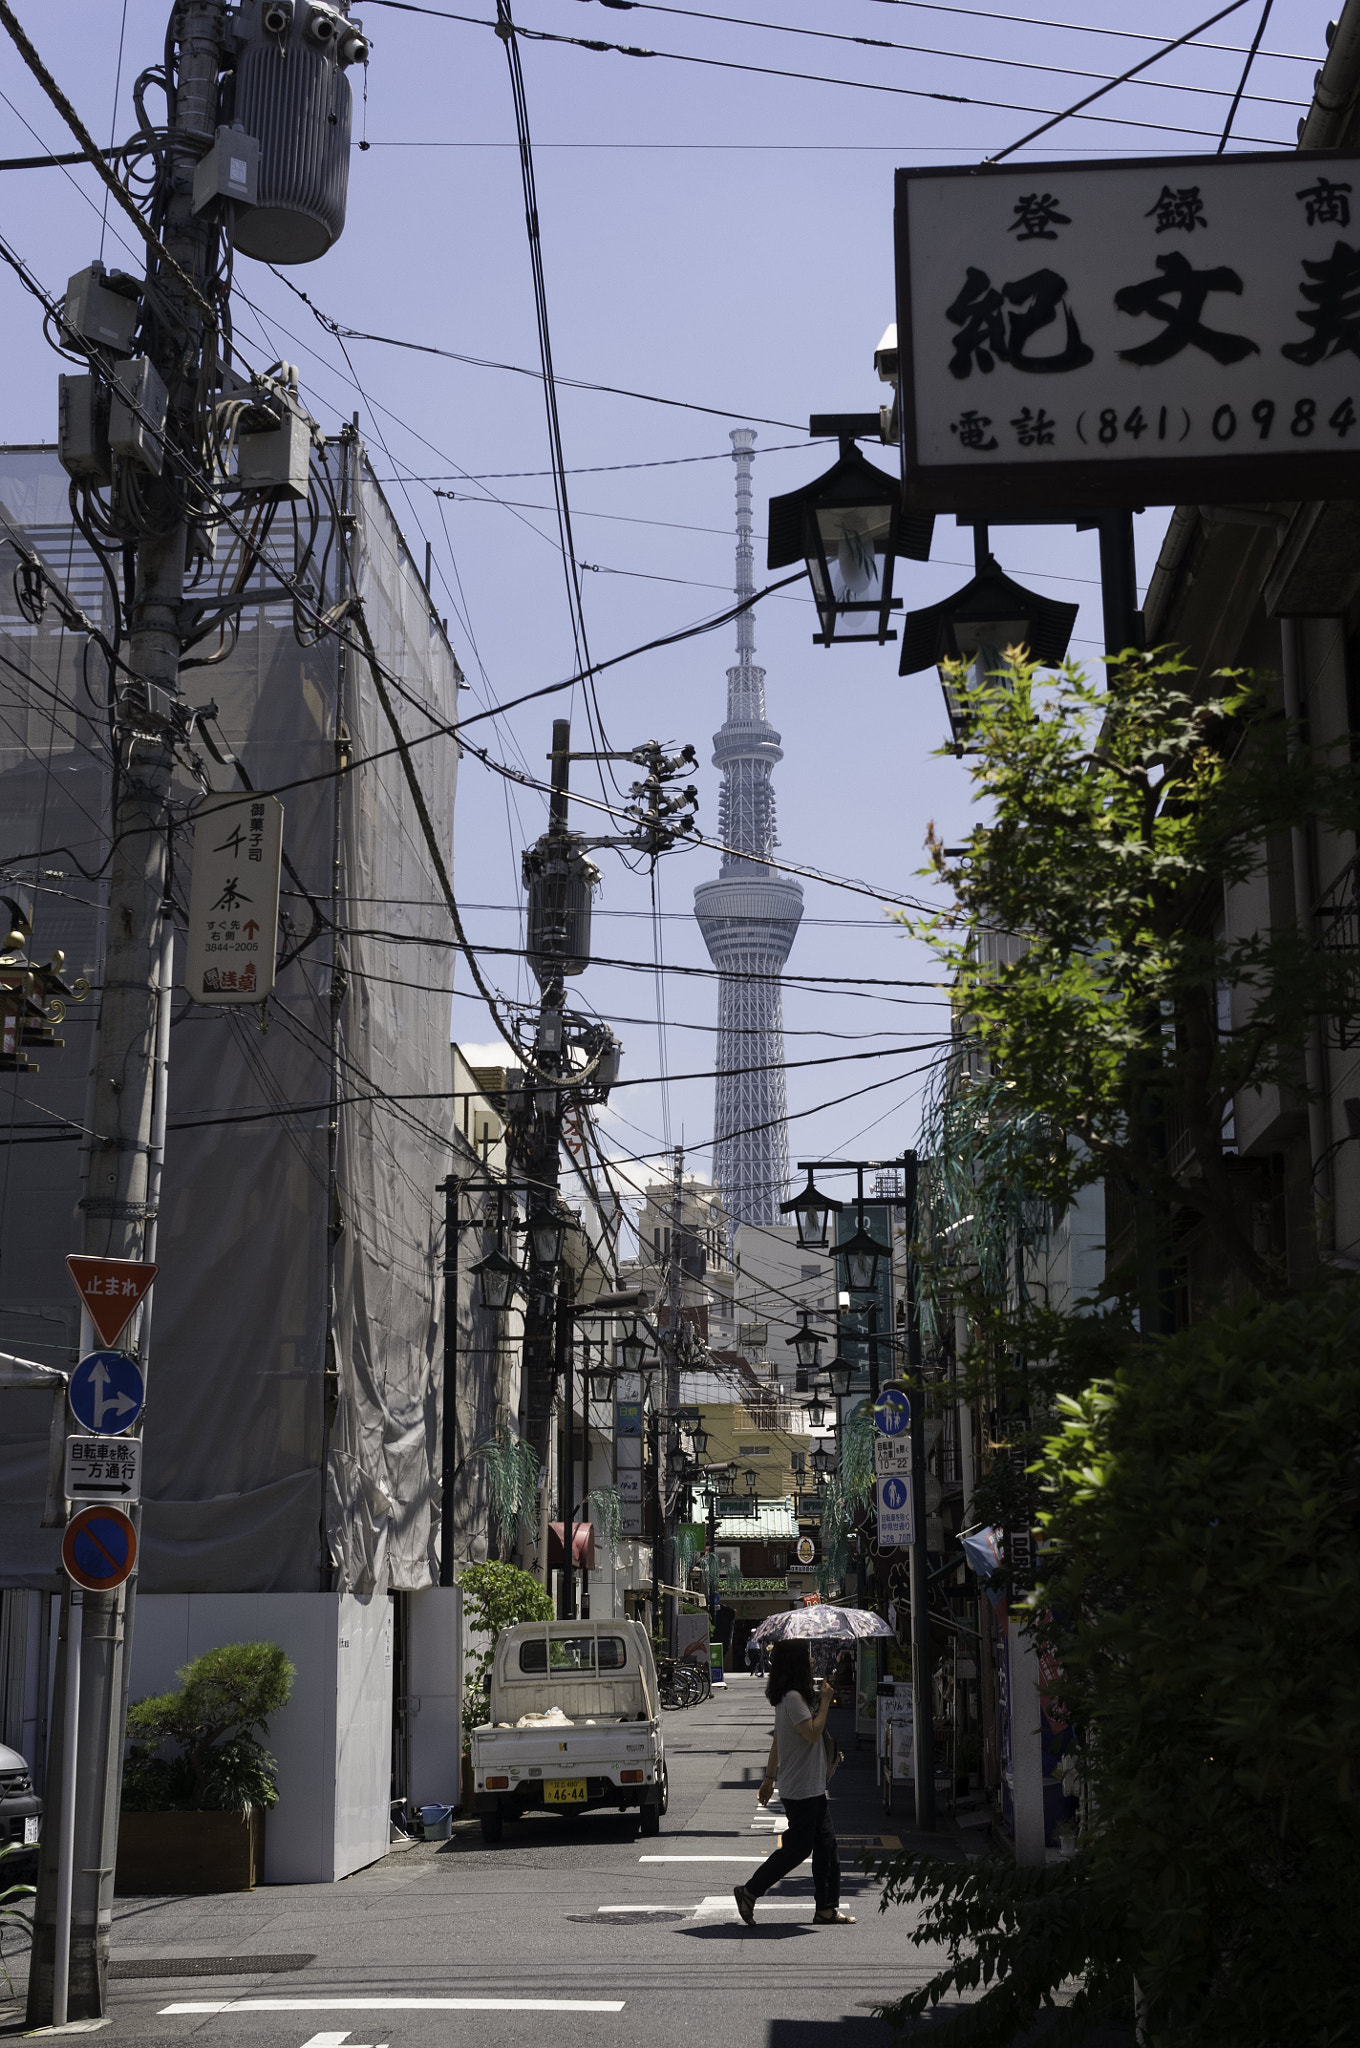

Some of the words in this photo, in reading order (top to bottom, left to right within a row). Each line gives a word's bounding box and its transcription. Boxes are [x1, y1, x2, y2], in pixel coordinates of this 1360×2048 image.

[248, 803, 265, 862] 御菓子司
[210, 931, 235, 941] 右側
[205, 942, 259, 952] 3844-2005
[85, 1275, 139, 1297] 止まれ
[72, 1443, 136, 1461] 自転車を除く
[71, 1462, 136, 1480] 一方通行
[554, 1788, 584, 1800] 46-44
